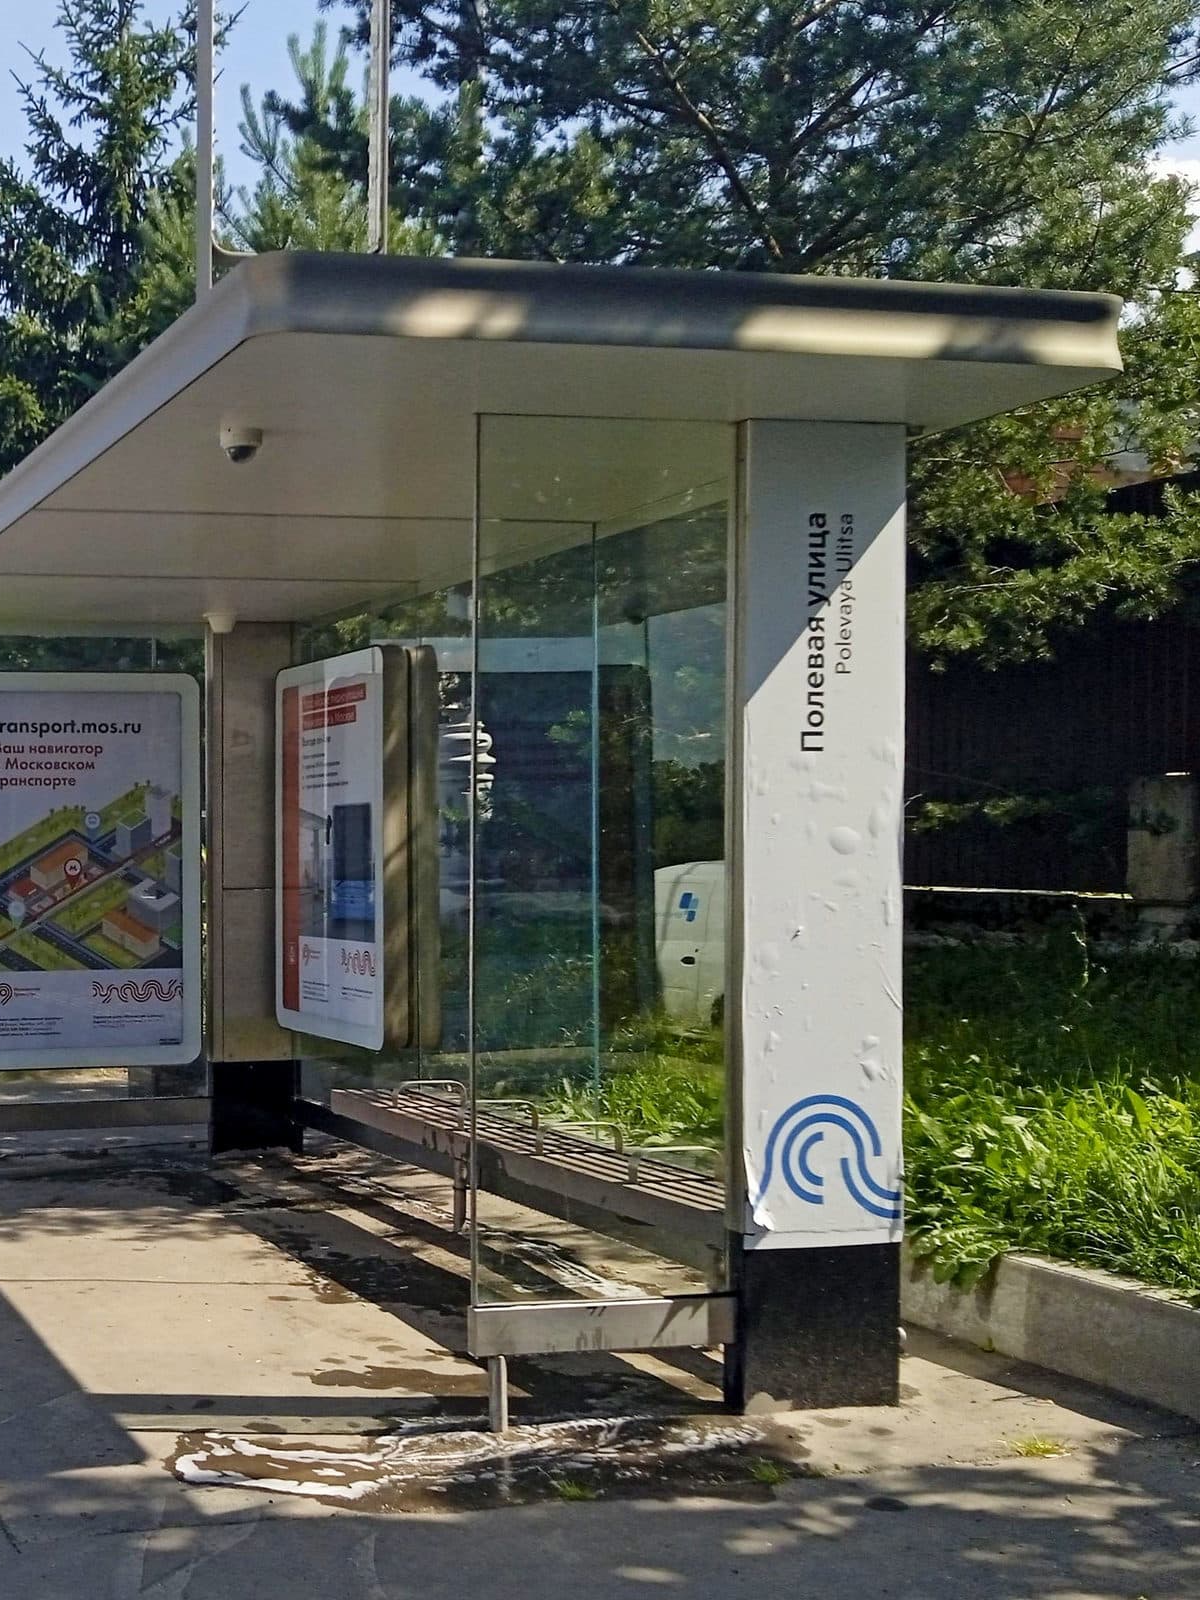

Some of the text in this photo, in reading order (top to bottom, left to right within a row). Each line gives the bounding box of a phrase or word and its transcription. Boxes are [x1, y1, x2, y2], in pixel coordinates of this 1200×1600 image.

[800, 512, 831, 752] Полевая улица
[835, 513, 856, 674] Polevaya Ulitsa
[5, 757, 95, 770] Московском
[29, 744, 104, 757] навигатор
